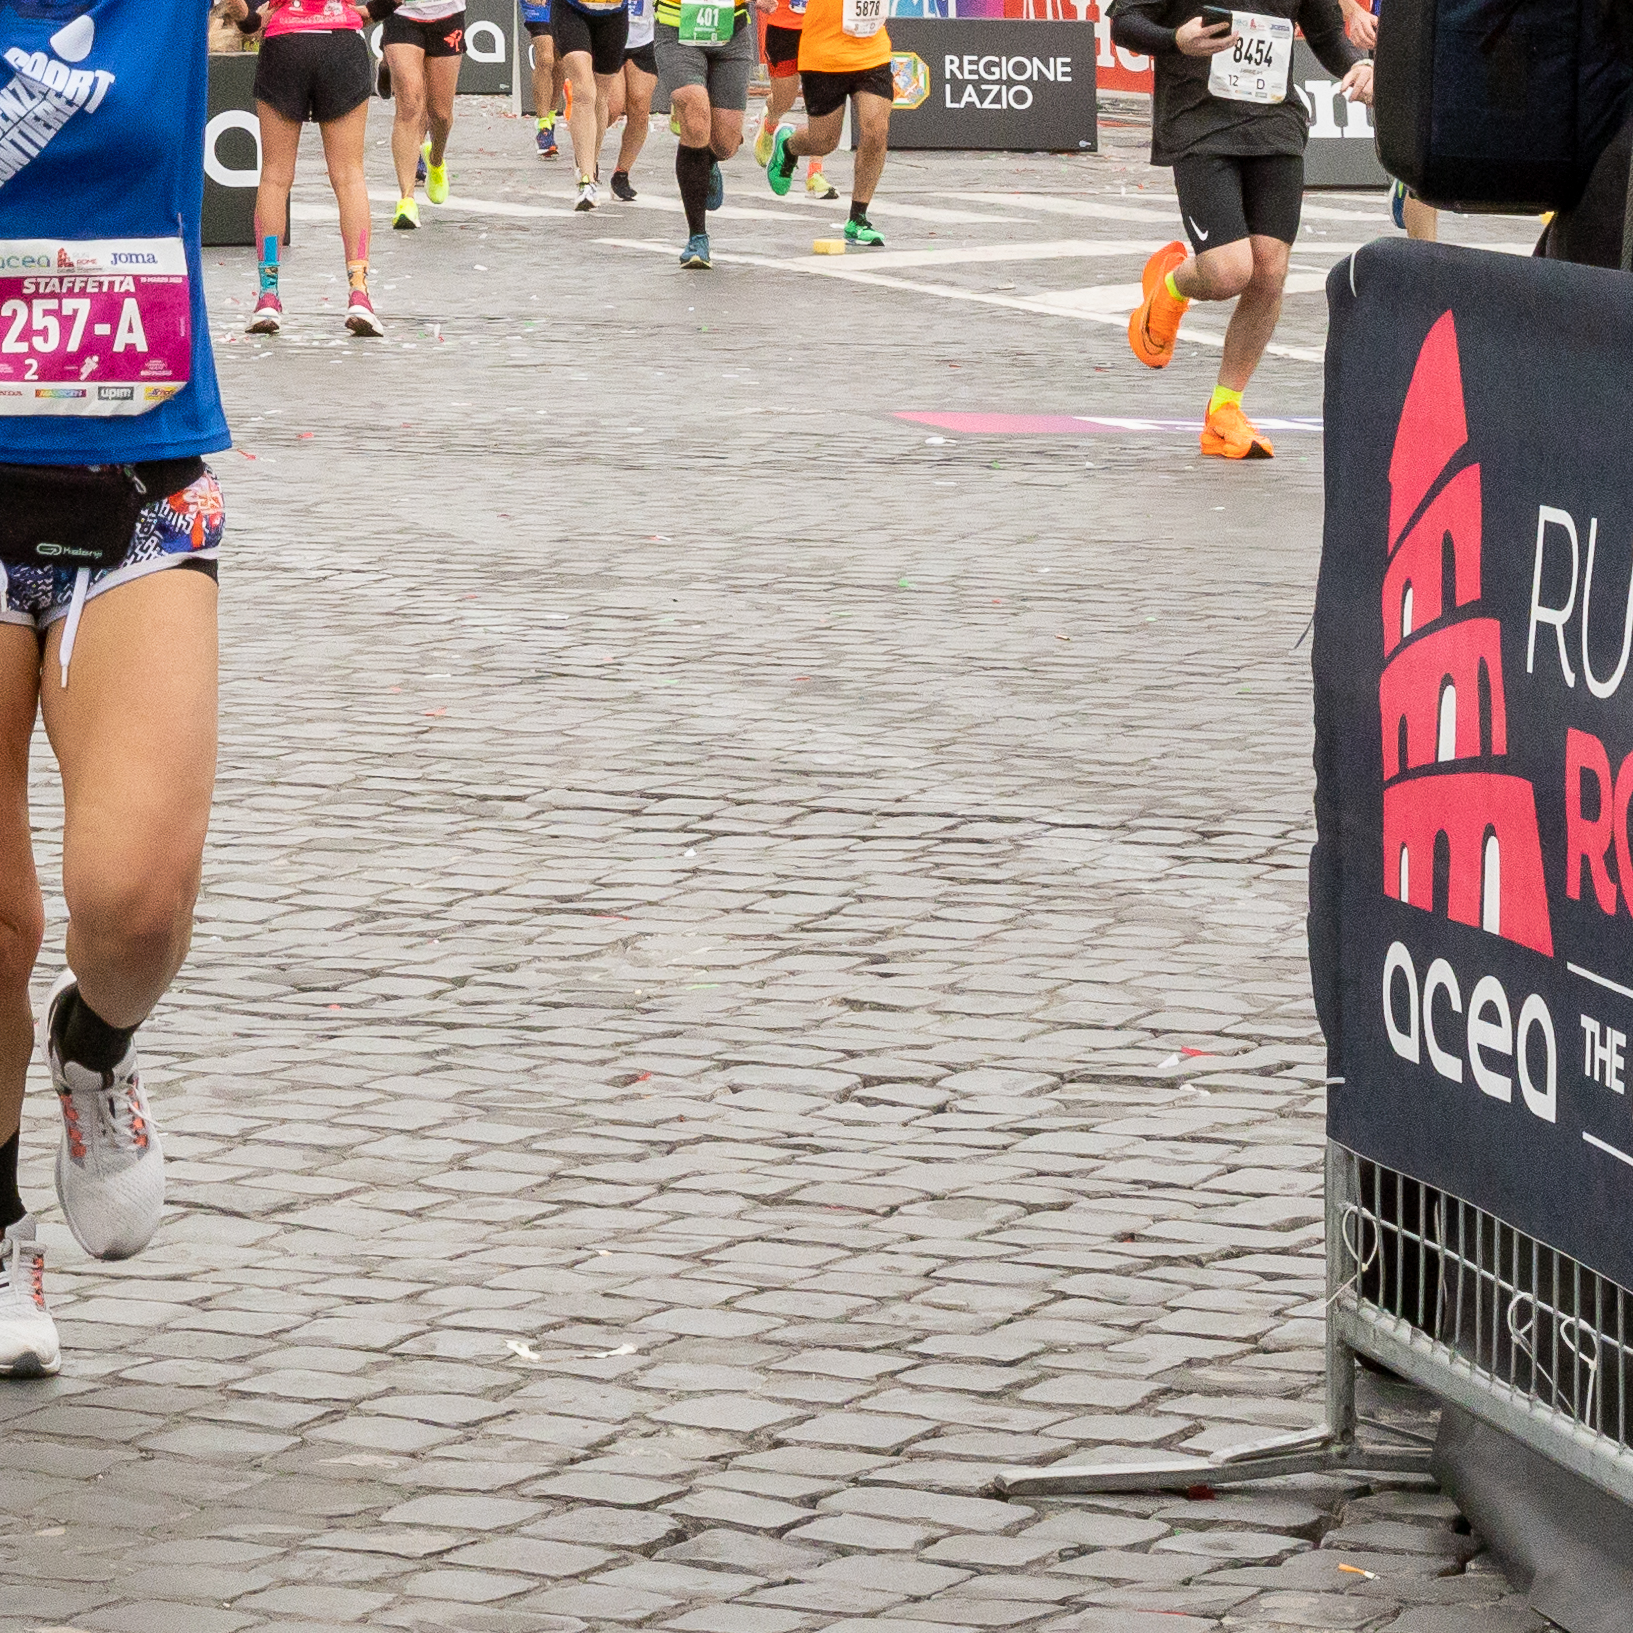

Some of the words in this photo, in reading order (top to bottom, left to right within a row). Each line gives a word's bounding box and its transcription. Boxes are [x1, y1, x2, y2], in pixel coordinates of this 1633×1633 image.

[696, 7, 720, 27] 401
[855, 0, 881, 17] 5878
[1233, 36, 1274, 68] 8454
[944, 54, 1072, 82] REGIONE
[1227, 74, 1239, 87] 12
[1256, 78, 1266, 90] D
[944, 84, 1034, 110] LAZIO
[22, 276, 136, 294] STAFFETTA
[0, 297, 149, 354] 257-A
[24, 358, 39, 381] 2
[1382, 940, 1557, 1124] acea
[1580, 1013, 1627, 1095] THE
